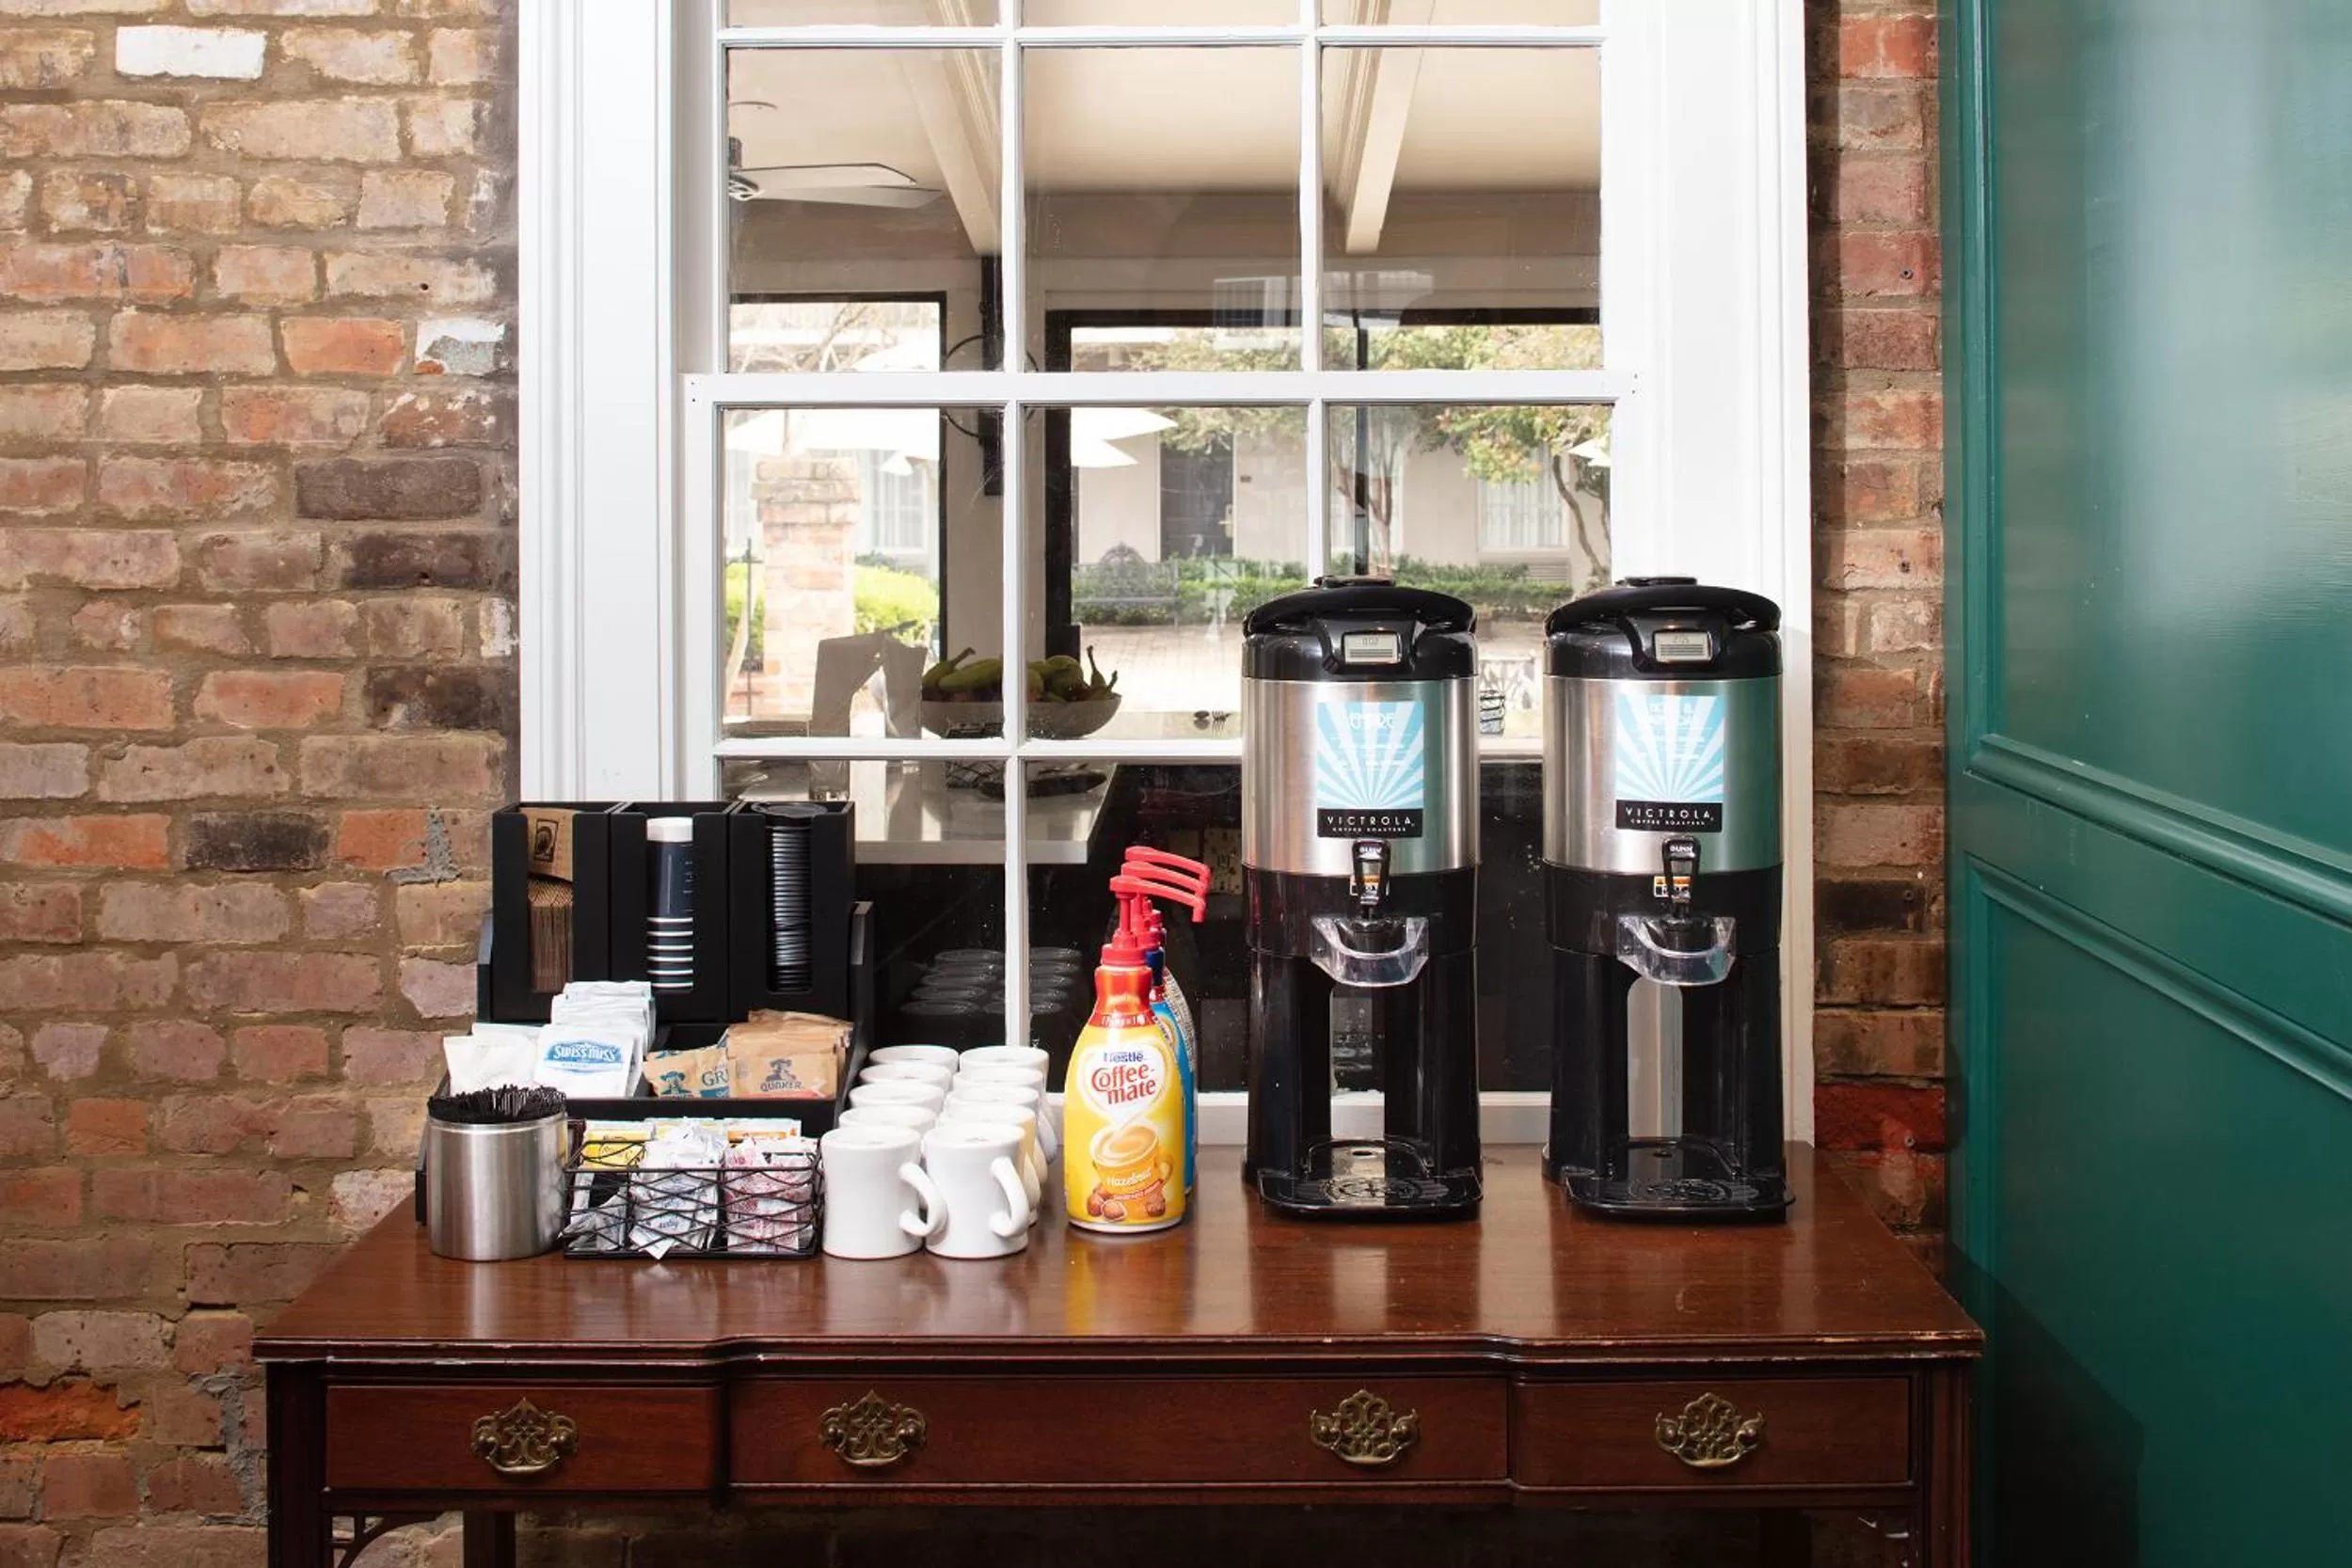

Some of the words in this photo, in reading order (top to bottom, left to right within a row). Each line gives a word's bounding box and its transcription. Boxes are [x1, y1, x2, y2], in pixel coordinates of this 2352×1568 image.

[1626, 807, 1709, 819] VICTROLA
[1327, 816, 1411, 826] VICTROLA
[1107, 1079, 1155, 1104] mate
